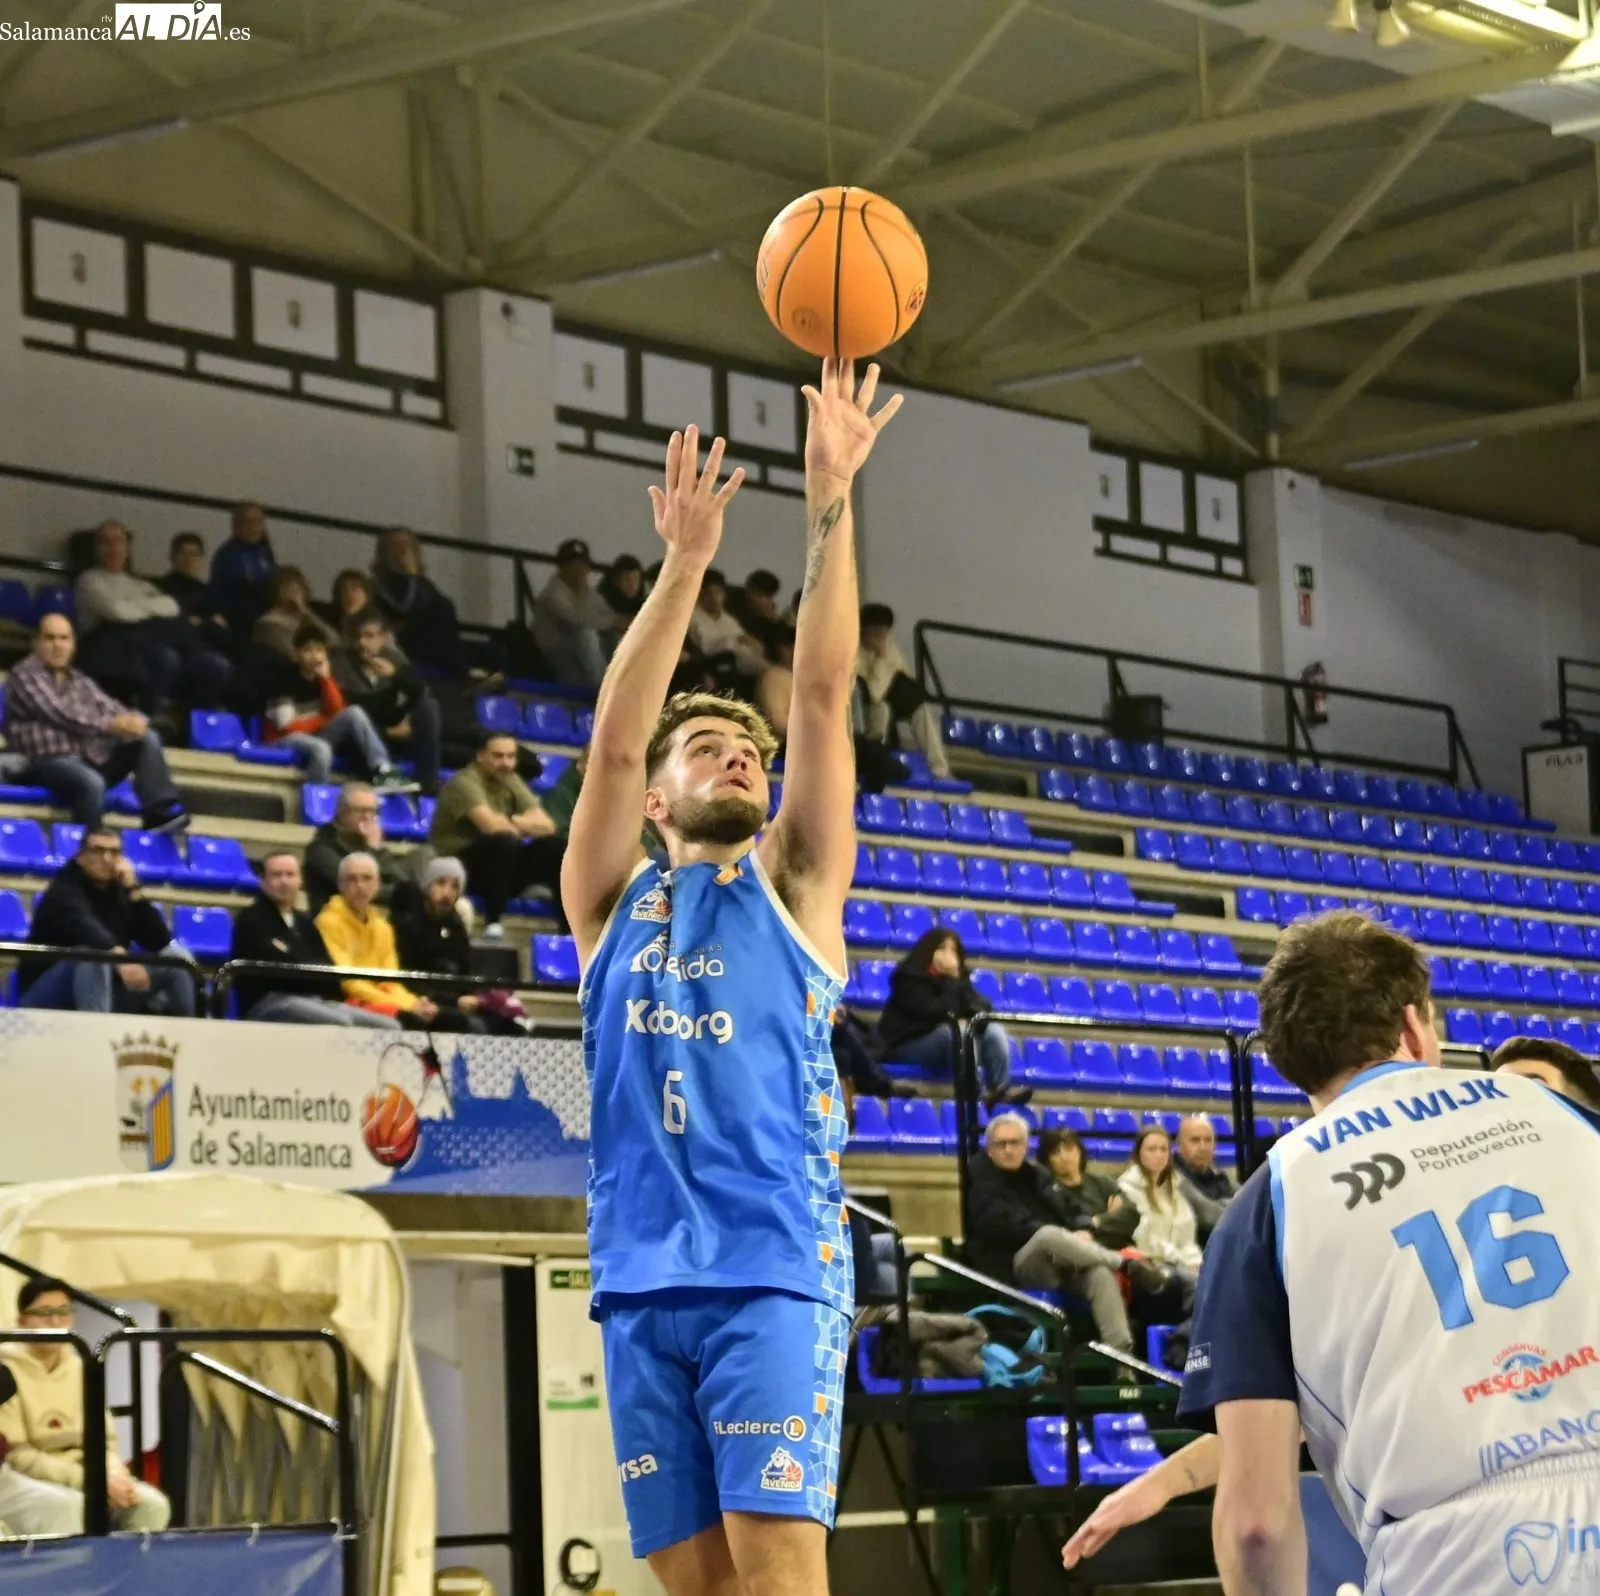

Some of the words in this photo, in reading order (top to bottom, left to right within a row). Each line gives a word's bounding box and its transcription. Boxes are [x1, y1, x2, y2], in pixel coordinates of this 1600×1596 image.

[188, 1082, 352, 1127] Ayuntamiento
[663, 1069, 687, 1135] 6
[1303, 1105, 1393, 1154] VAN
[1393, 1077, 1510, 1122] WIJK
[189, 1129, 219, 1166] de
[226, 1130, 353, 1169] Salamanca
[1409, 1119, 1535, 1160] Deputación
[1418, 1133, 1543, 1173] Pontevedra
[1390, 1184, 1570, 1331] 16
[1462, 1345, 1600, 1404] PESCAMAR
